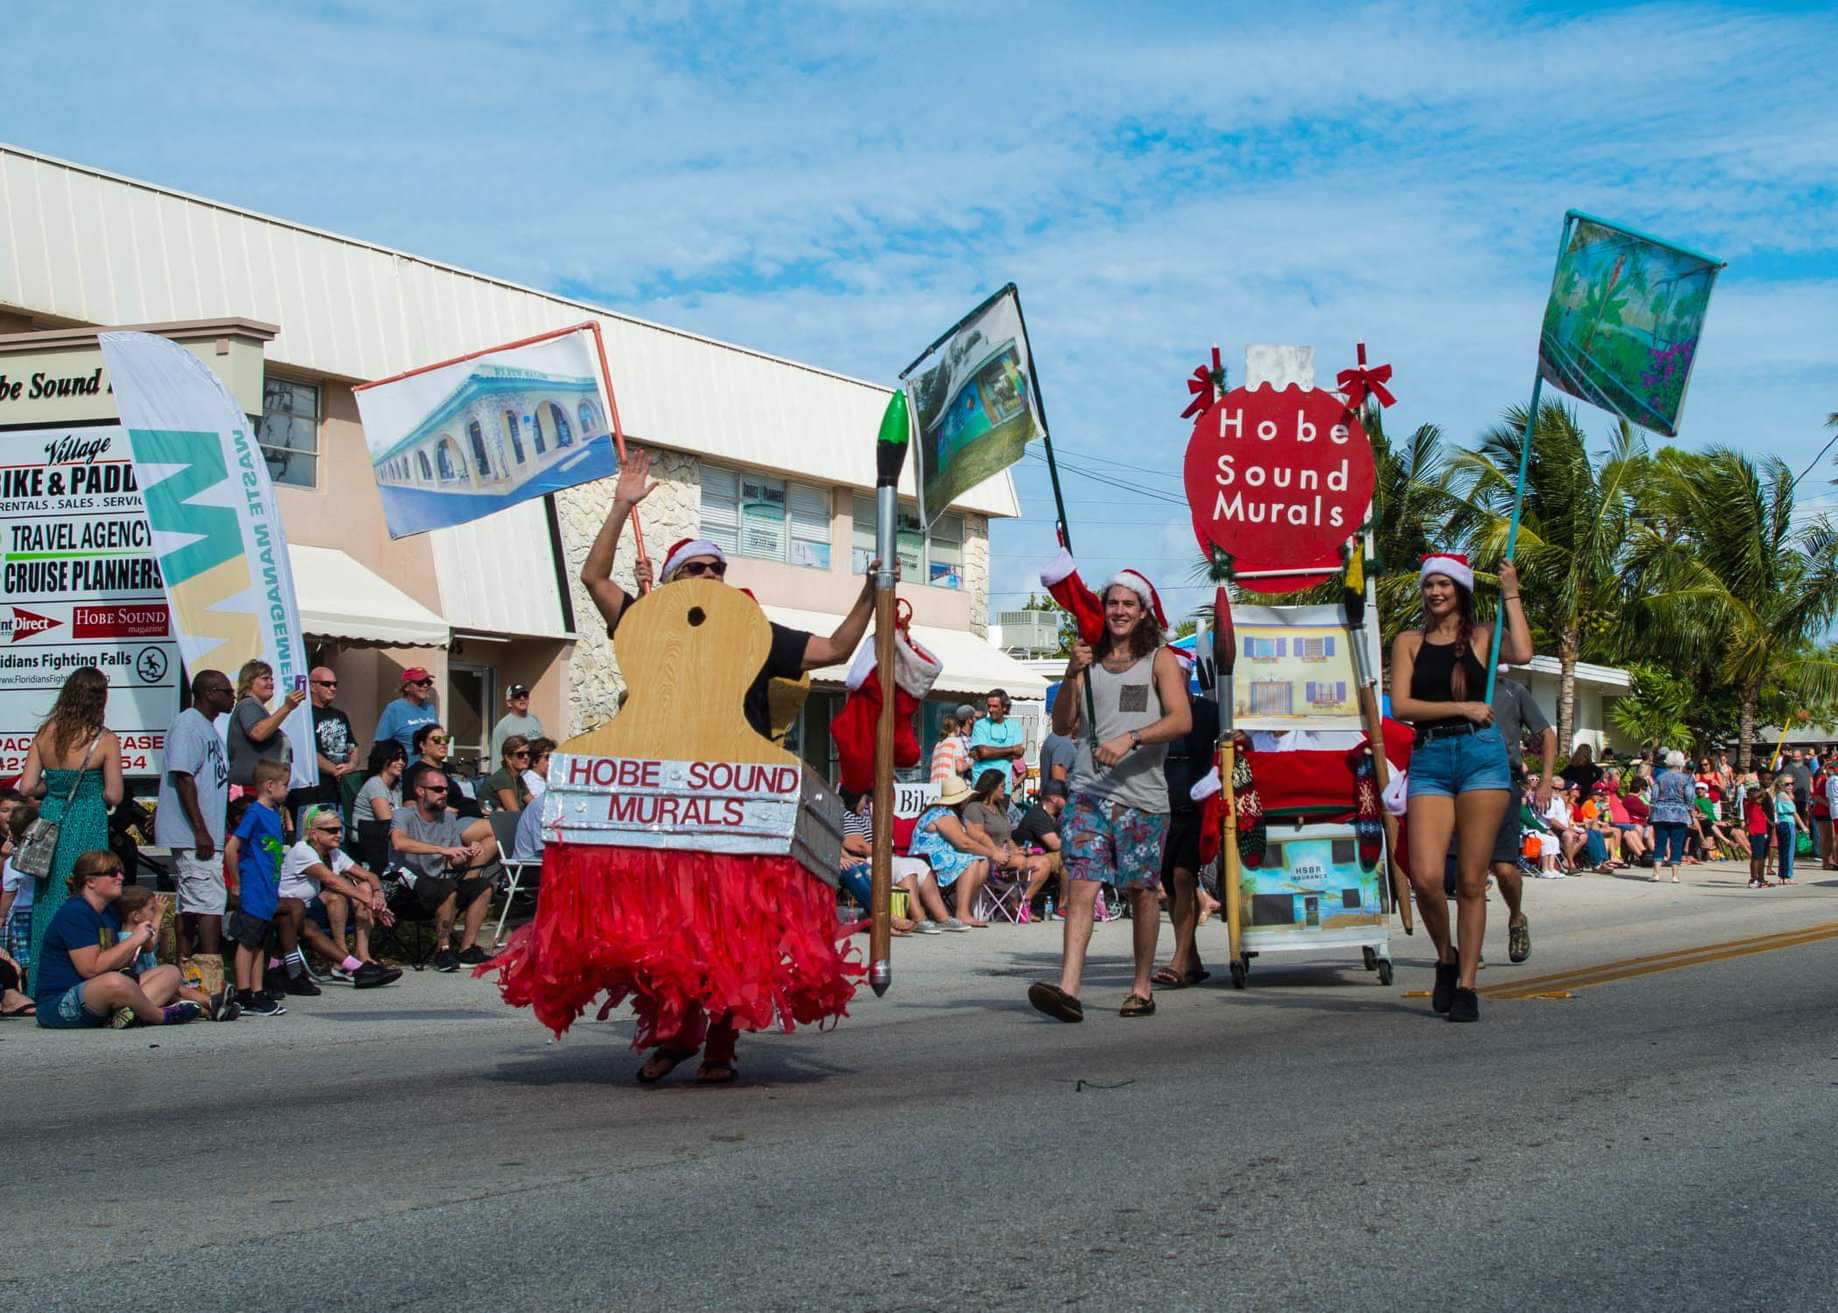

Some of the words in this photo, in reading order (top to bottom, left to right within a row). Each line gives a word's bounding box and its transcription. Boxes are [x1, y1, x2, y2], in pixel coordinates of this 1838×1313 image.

[29, 368, 102, 399] Sound
[1219, 408, 1350, 444] Hobe
[45, 435, 111, 466] Village
[0, 468, 44, 498] IKE
[48, 472, 66, 496] &
[1216, 454, 1349, 491] Sound
[0, 500, 48, 511] RENTALS
[58, 498, 94, 508] SALES
[1212, 490, 1344, 528] Murals
[11, 523, 77, 551] TRAVEL
[4, 561, 68, 594] CRUISE
[76, 609, 115, 625] HOBE
[118, 608, 166, 624] SOUND
[128, 625, 166, 635] magazine
[42, 653, 98, 670] Fighting
[101, 651, 132, 666] Falls
[568, 758, 661, 788] HOBE
[686, 761, 798, 794] SOUND
[608, 794, 744, 826] MURALS
[900, 789, 939, 813] Bik
